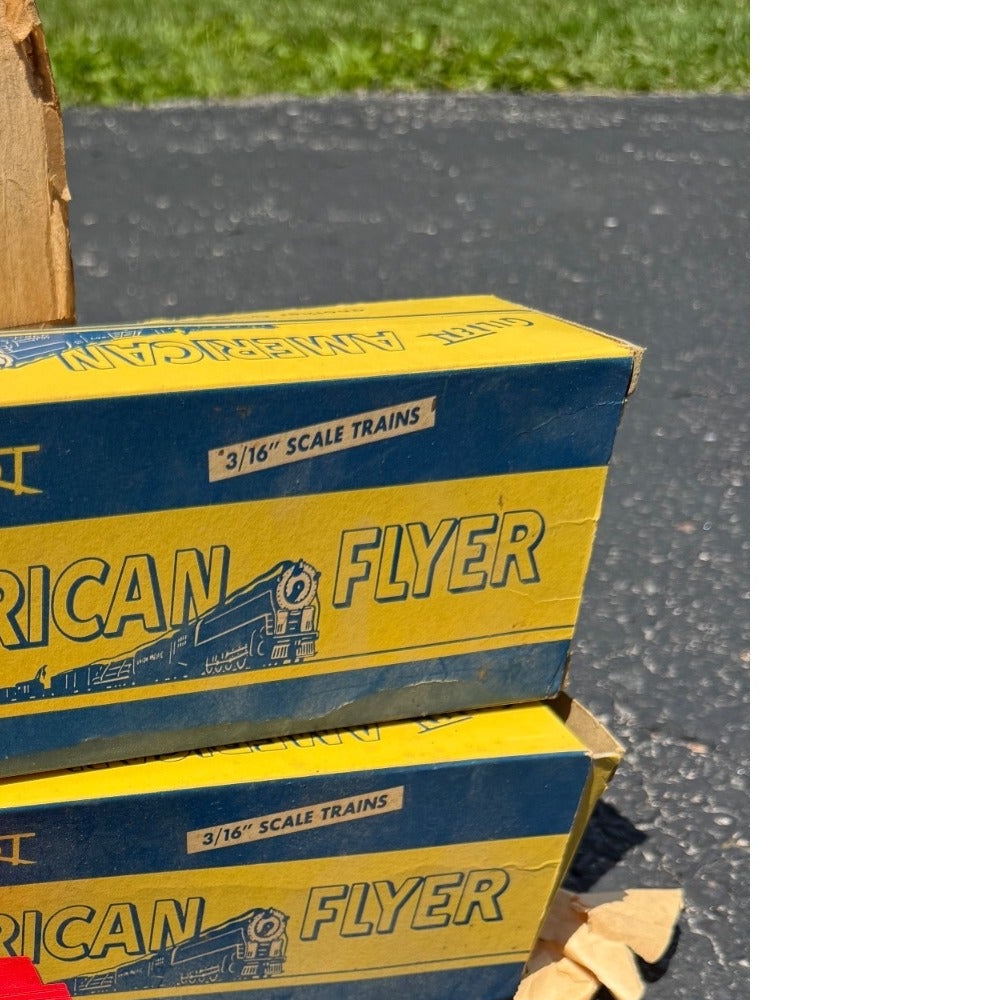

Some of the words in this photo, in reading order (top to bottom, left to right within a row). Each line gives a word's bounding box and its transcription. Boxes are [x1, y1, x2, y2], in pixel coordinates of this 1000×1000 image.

[56, 330, 406, 372] AMERICAN
[284, 424, 346, 457] SCALE
[349, 405, 421, 438] TRAINS
[331, 509, 547, 610] FLYER
[258, 810, 314, 834] SCALE
[321, 793, 389, 822] TRAINS
[300, 867, 511, 942] FLYER
